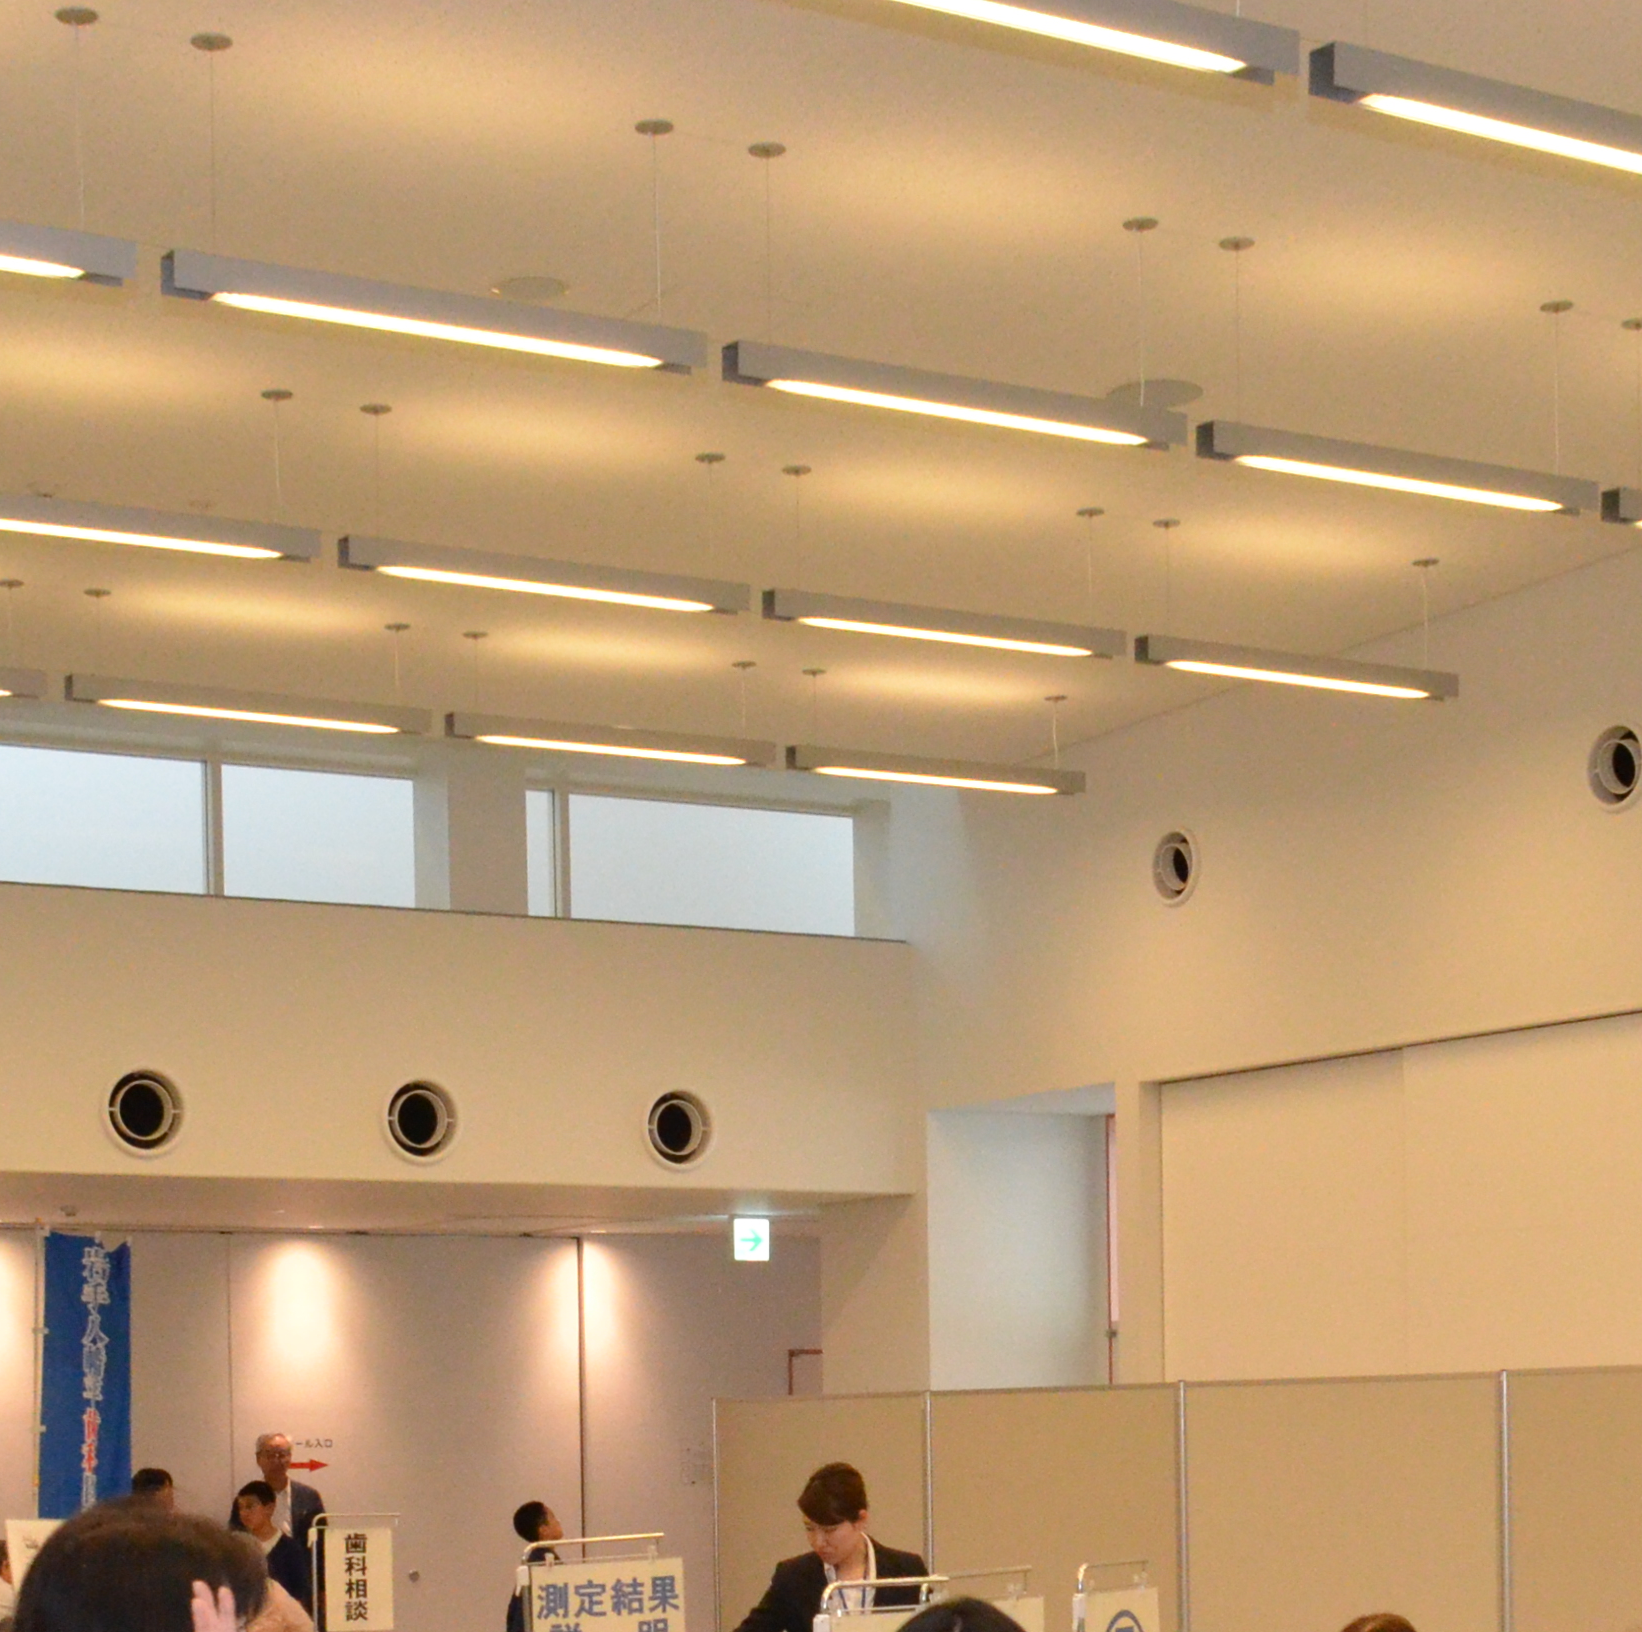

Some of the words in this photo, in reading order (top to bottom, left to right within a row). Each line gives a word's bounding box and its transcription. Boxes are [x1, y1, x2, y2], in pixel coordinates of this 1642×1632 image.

[344, 1532, 368, 1622] 歯科相談
[536, 1575, 680, 1620] 測定結果
